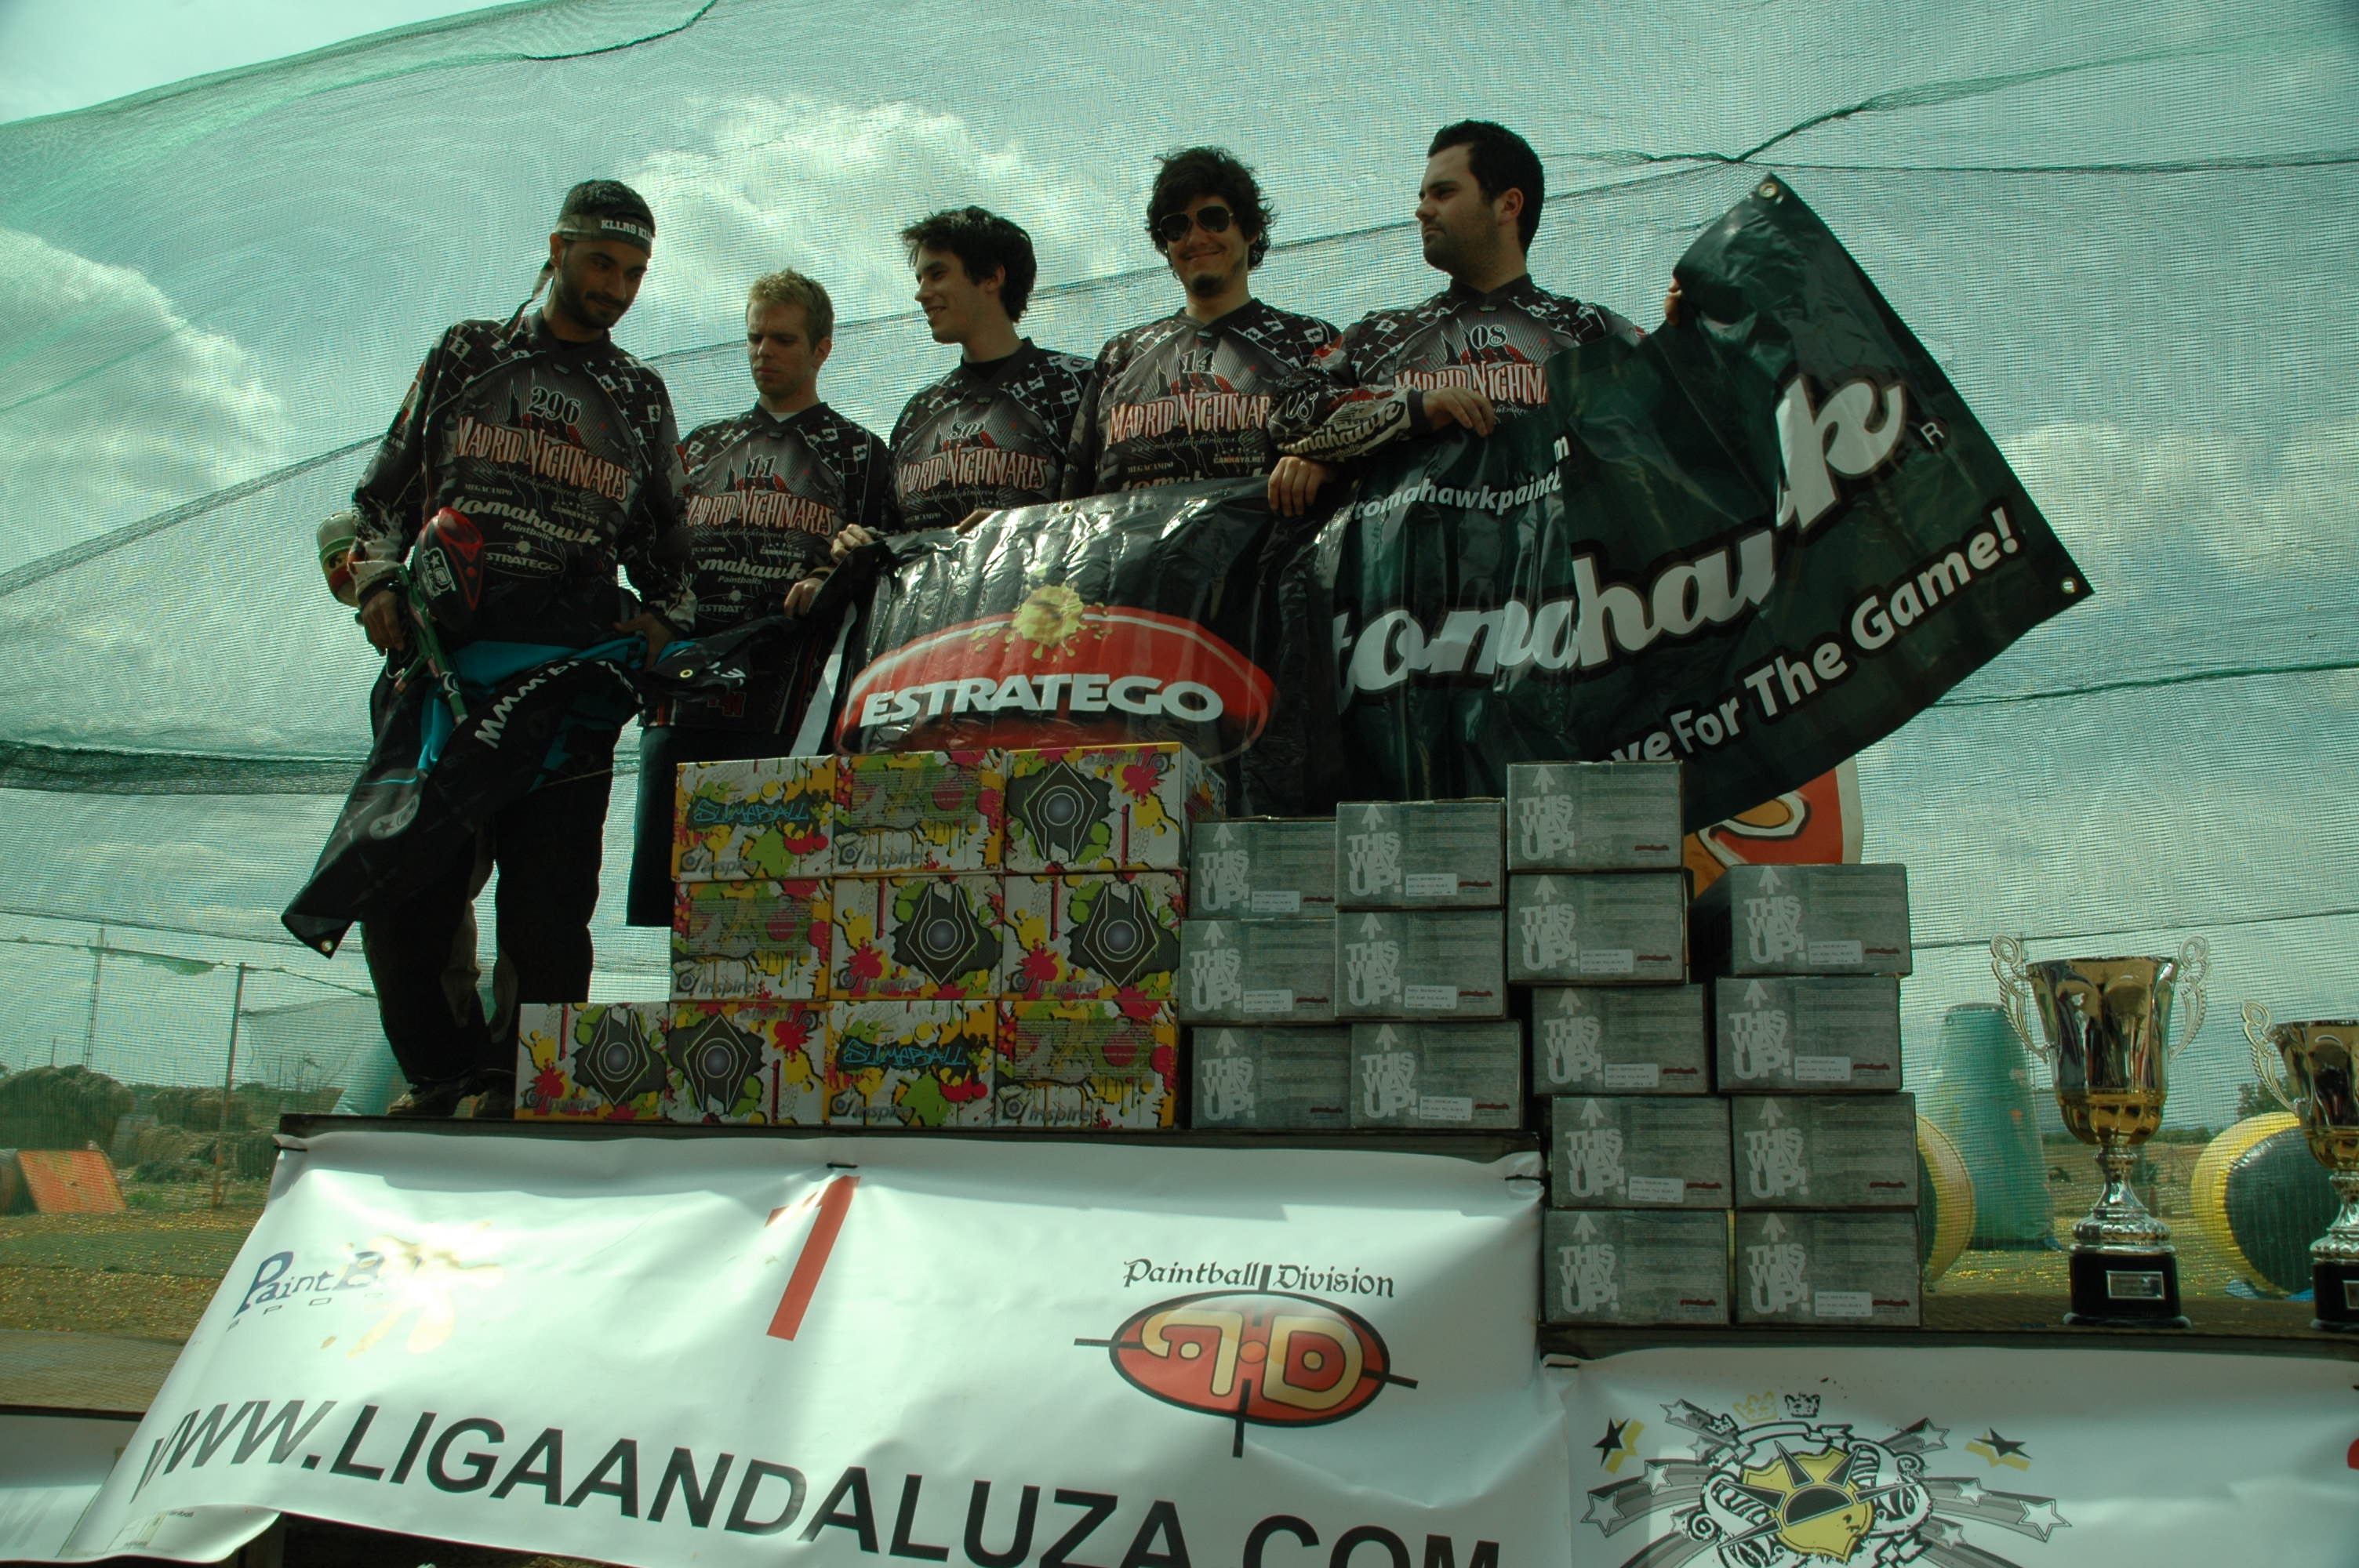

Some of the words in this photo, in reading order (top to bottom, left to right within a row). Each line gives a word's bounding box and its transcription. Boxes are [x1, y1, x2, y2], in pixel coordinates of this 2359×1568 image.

[1470, 325, 1507, 350] 08
[1181, 349, 1216, 374] 14
[1470, 361, 1550, 405] NIGHTM
[1105, 401, 1175, 452] MADRID
[1178, 388, 1272, 436] NIGHTMAR
[454, 416, 524, 463] MADRID
[526, 427, 631, 502] NIGHTMARES
[747, 454, 777, 478] 11
[944, 444, 1049, 491] NIGHTMARES
[451, 495, 602, 546] tomahawk
[738, 485, 836, 537] NIGHTMARES
[503, 521, 554, 543] Paintballs
[485, 552, 562, 572] STRATEGO
[696, 557, 808, 581] mahawk
[718, 575, 763, 586] Paintballs
[1670, 695, 1743, 755] For
[1743, 641, 1849, 718] The
[1850, 506, 2021, 652] Game!
[859, 672, 1224, 729] ESTRATEGO
[1518, 794, 1573, 818] THIS
[1519, 815, 1573, 836] WAY
[1347, 832, 1401, 855] THIS
[1521, 831, 1576, 860] UP!
[1199, 850, 1249, 872] THIS
[1348, 851, 1401, 872] WAY
[1201, 868, 1249, 887] WAY
[1350, 867, 1401, 895] UP!
[1201, 883, 1250, 910] UP!
[1743, 895, 1801, 917] THIS
[1519, 904, 1576, 927] THIS
[1746, 915, 1801, 938] WAY
[1521, 924, 1576, 946] WAY
[1190, 948, 1241, 970] THIS
[1346, 941, 1400, 964] THIS
[1523, 941, 1579, 970] UP!
[1749, 933, 1806, 964] UP!
[1190, 967, 1241, 988] WAY
[1347, 960, 1400, 981] WAY
[1191, 982, 1241, 1011] UP!
[1348, 976, 1401, 1006] UP!
[1543, 1016, 1601, 1040] THIS
[1728, 1010, 1787, 1033] THIS
[1546, 1036, 1601, 1058] WAY
[1732, 1029, 1787, 1053] WAY
[1201, 1057, 1253, 1080] THIS
[1361, 1052, 1416, 1075] THIS
[1547, 1053, 1603, 1083] UP!
[1734, 1047, 1792, 1080] UP!
[1203, 1076, 1253, 1098] WAY
[1362, 1072, 1416, 1093] WAY
[1204, 1092, 1255, 1120] UP!
[1363, 1088, 1417, 1118] UP!
[1565, 1129, 1623, 1151] THIS
[1744, 1127, 1803, 1151] THIS
[1568, 1149, 1623, 1171] WAY
[1746, 1149, 1804, 1171] WAY
[1569, 1166, 1627, 1198] UP!
[1749, 1166, 1809, 1198] UP!
[1558, 1243, 1616, 1267] THIS
[1746, 1243, 1806, 1267] THIS
[1123, 1258, 1260, 1288] Paintball
[1273, 1265, 1394, 1298] Division
[1560, 1265, 1616, 1287] WAY
[1748, 1265, 1806, 1287] WAY
[1561, 1282, 1619, 1315] UP!
[1750, 1282, 1811, 1315] UP!
